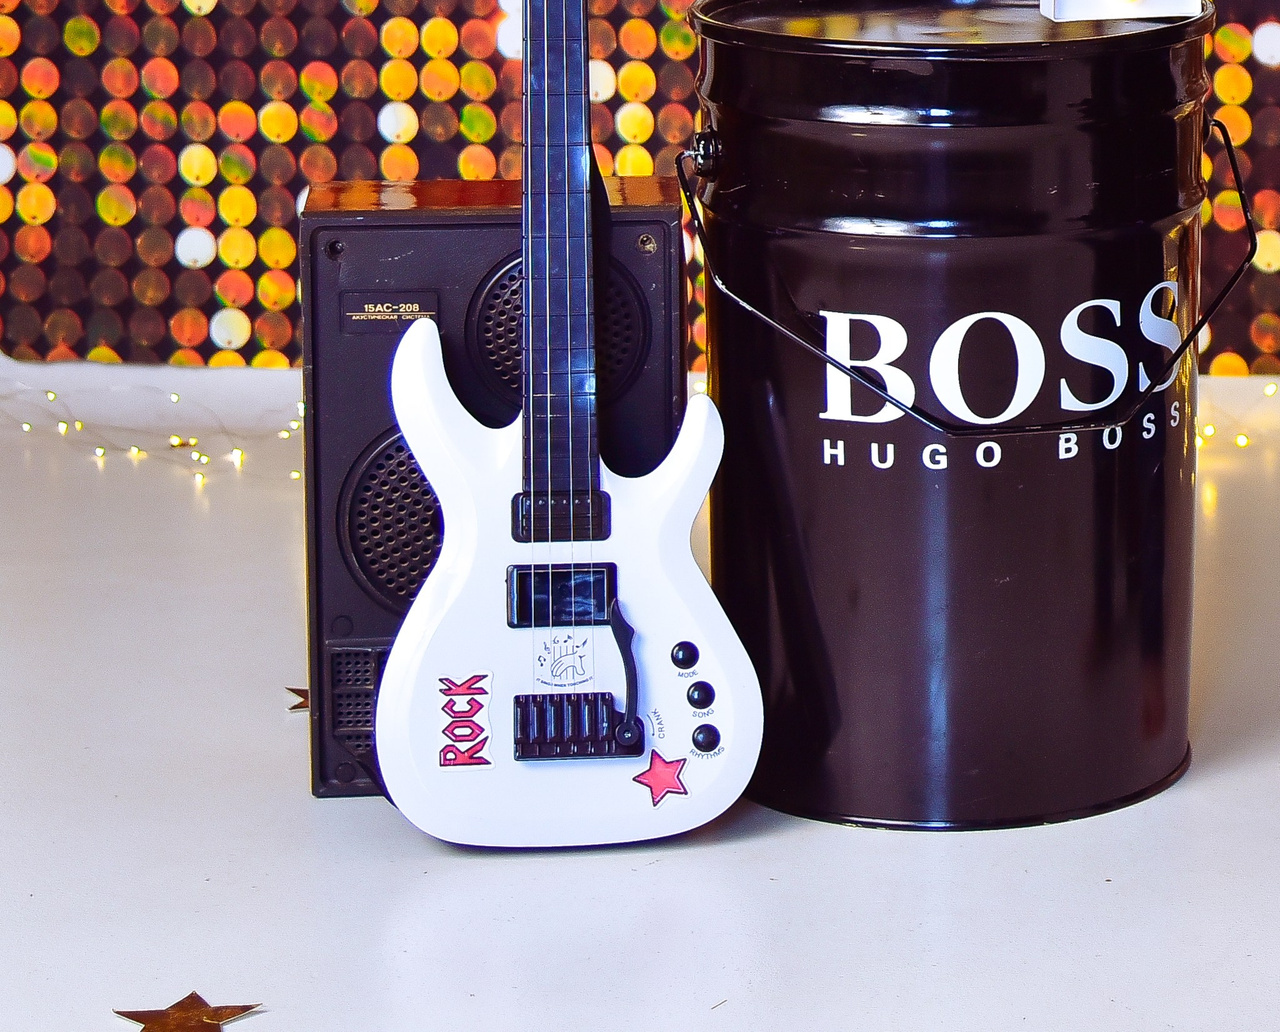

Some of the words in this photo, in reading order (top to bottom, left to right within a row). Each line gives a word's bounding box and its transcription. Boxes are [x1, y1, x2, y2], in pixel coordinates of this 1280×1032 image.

[818, 280, 1183, 426] BOSS
[823, 439, 1002, 470] HUGO
[1058, 400, 1180, 460] BOSS
[677, 669, 699, 678] MODE
[438, 674, 492, 767] ROCK
[651, 708, 666, 739] CRANK
[692, 708, 714, 718] SONG
[689, 746, 725, 759] RHYTHMS
